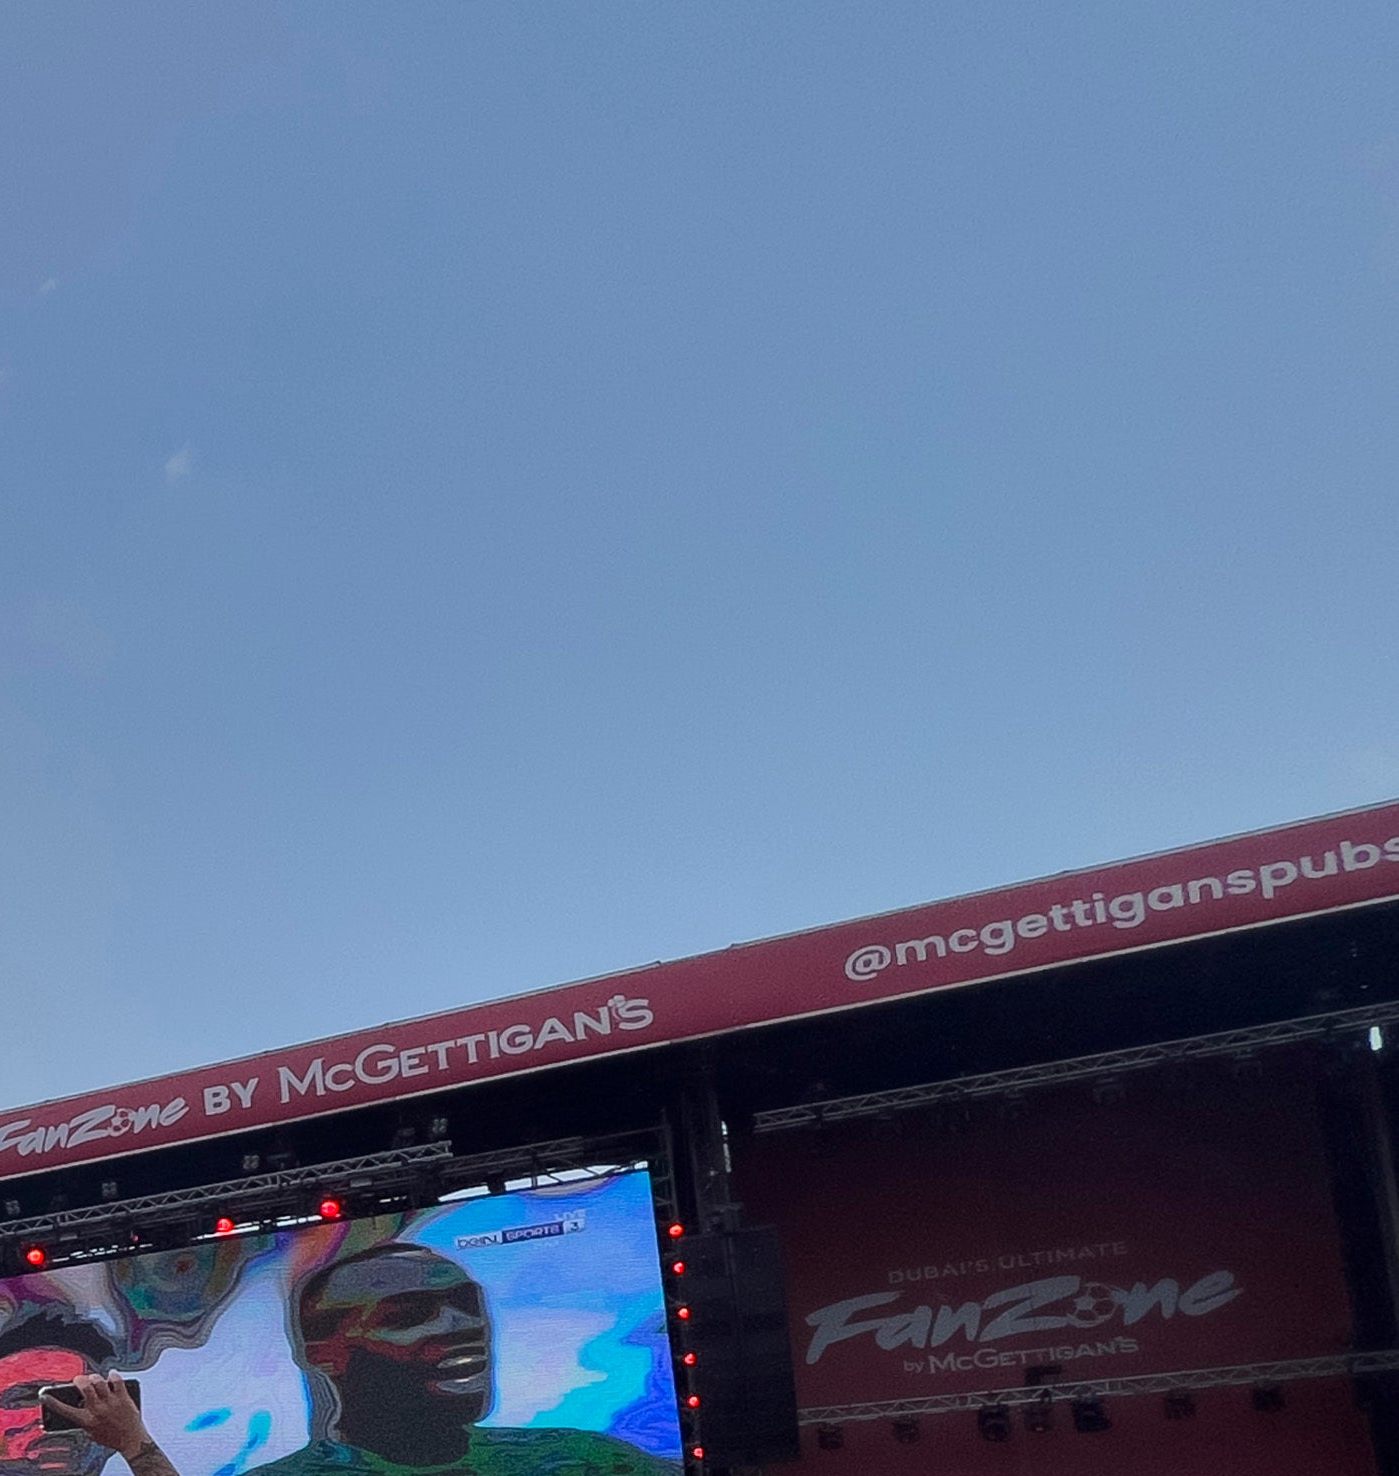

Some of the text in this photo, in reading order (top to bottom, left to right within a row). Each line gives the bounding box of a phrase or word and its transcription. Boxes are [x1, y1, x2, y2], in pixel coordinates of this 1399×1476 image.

[204, 1077, 259, 1115] BY
[506, 1225, 560, 1241] SPORTS
[570, 1222, 580, 1232] 3
[888, 1242, 1128, 1284] DUBAI'S ULTIMATE
[806, 1270, 1243, 1364] FanZone
[904, 1360, 924, 1374] by
